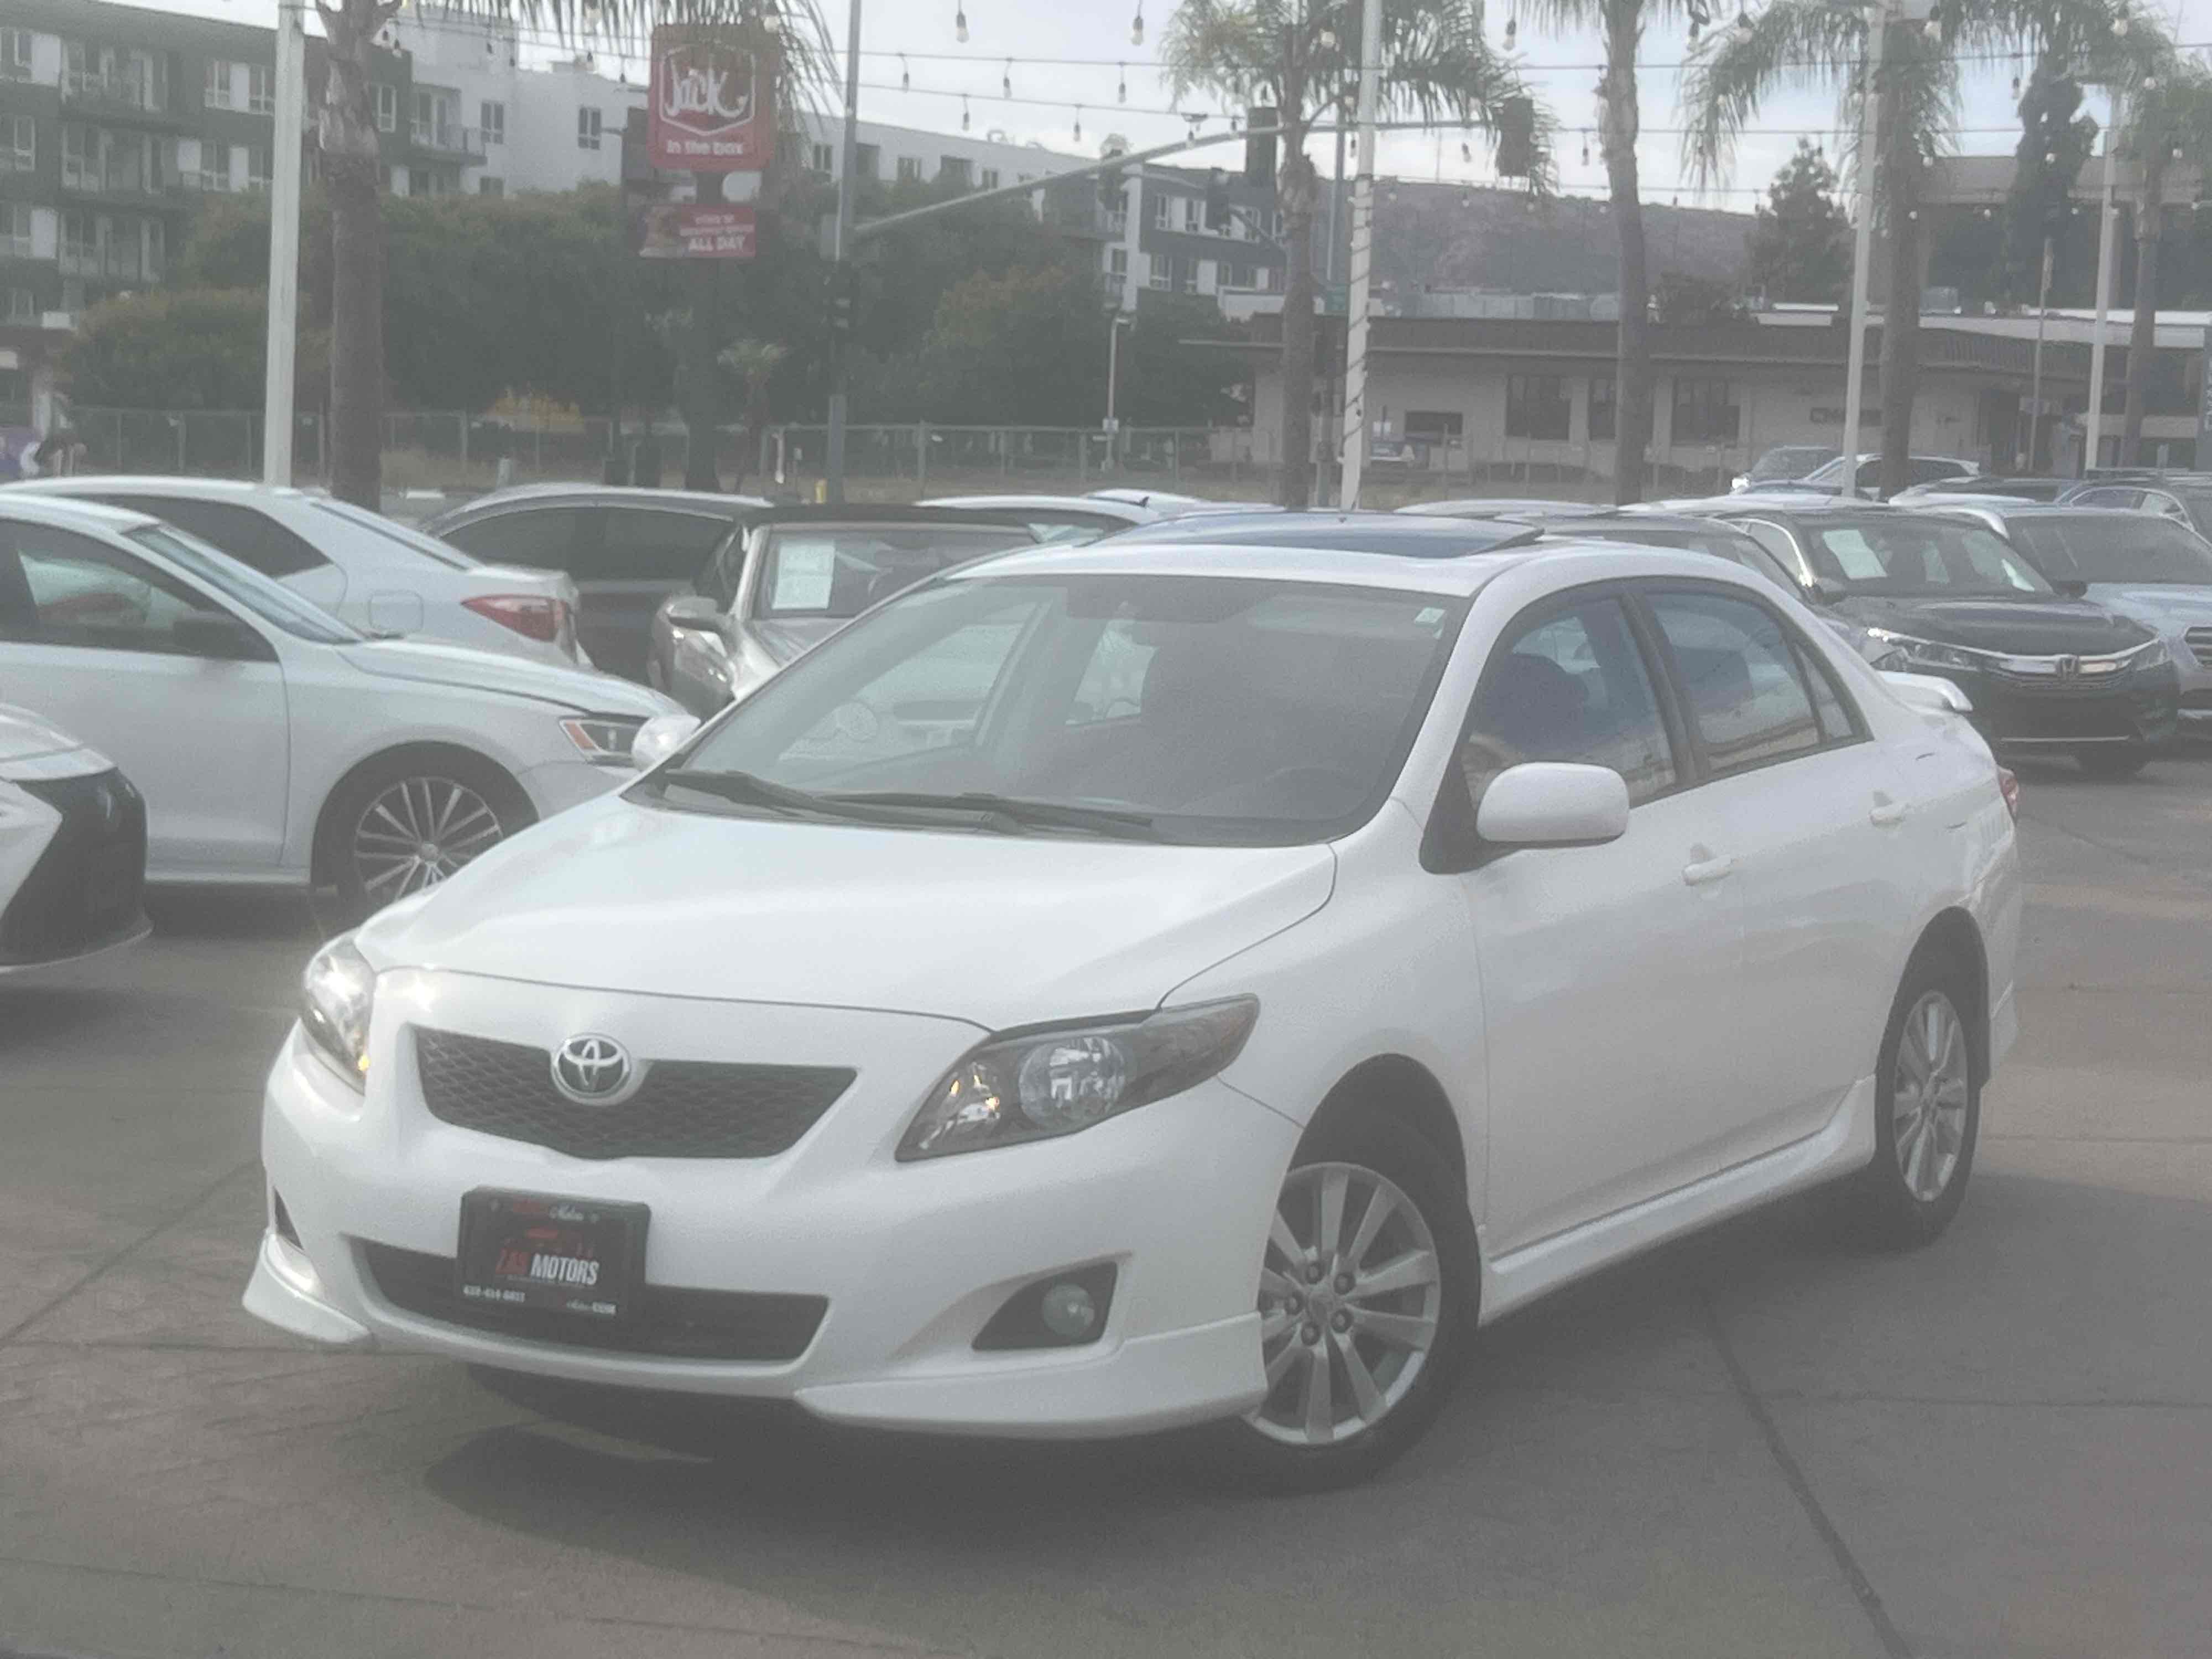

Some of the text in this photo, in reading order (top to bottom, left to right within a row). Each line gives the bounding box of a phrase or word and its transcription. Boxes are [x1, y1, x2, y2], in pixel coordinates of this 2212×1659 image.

[688, 236, 746, 252] ALL DAY
[531, 1253, 600, 1286] MOTORS
